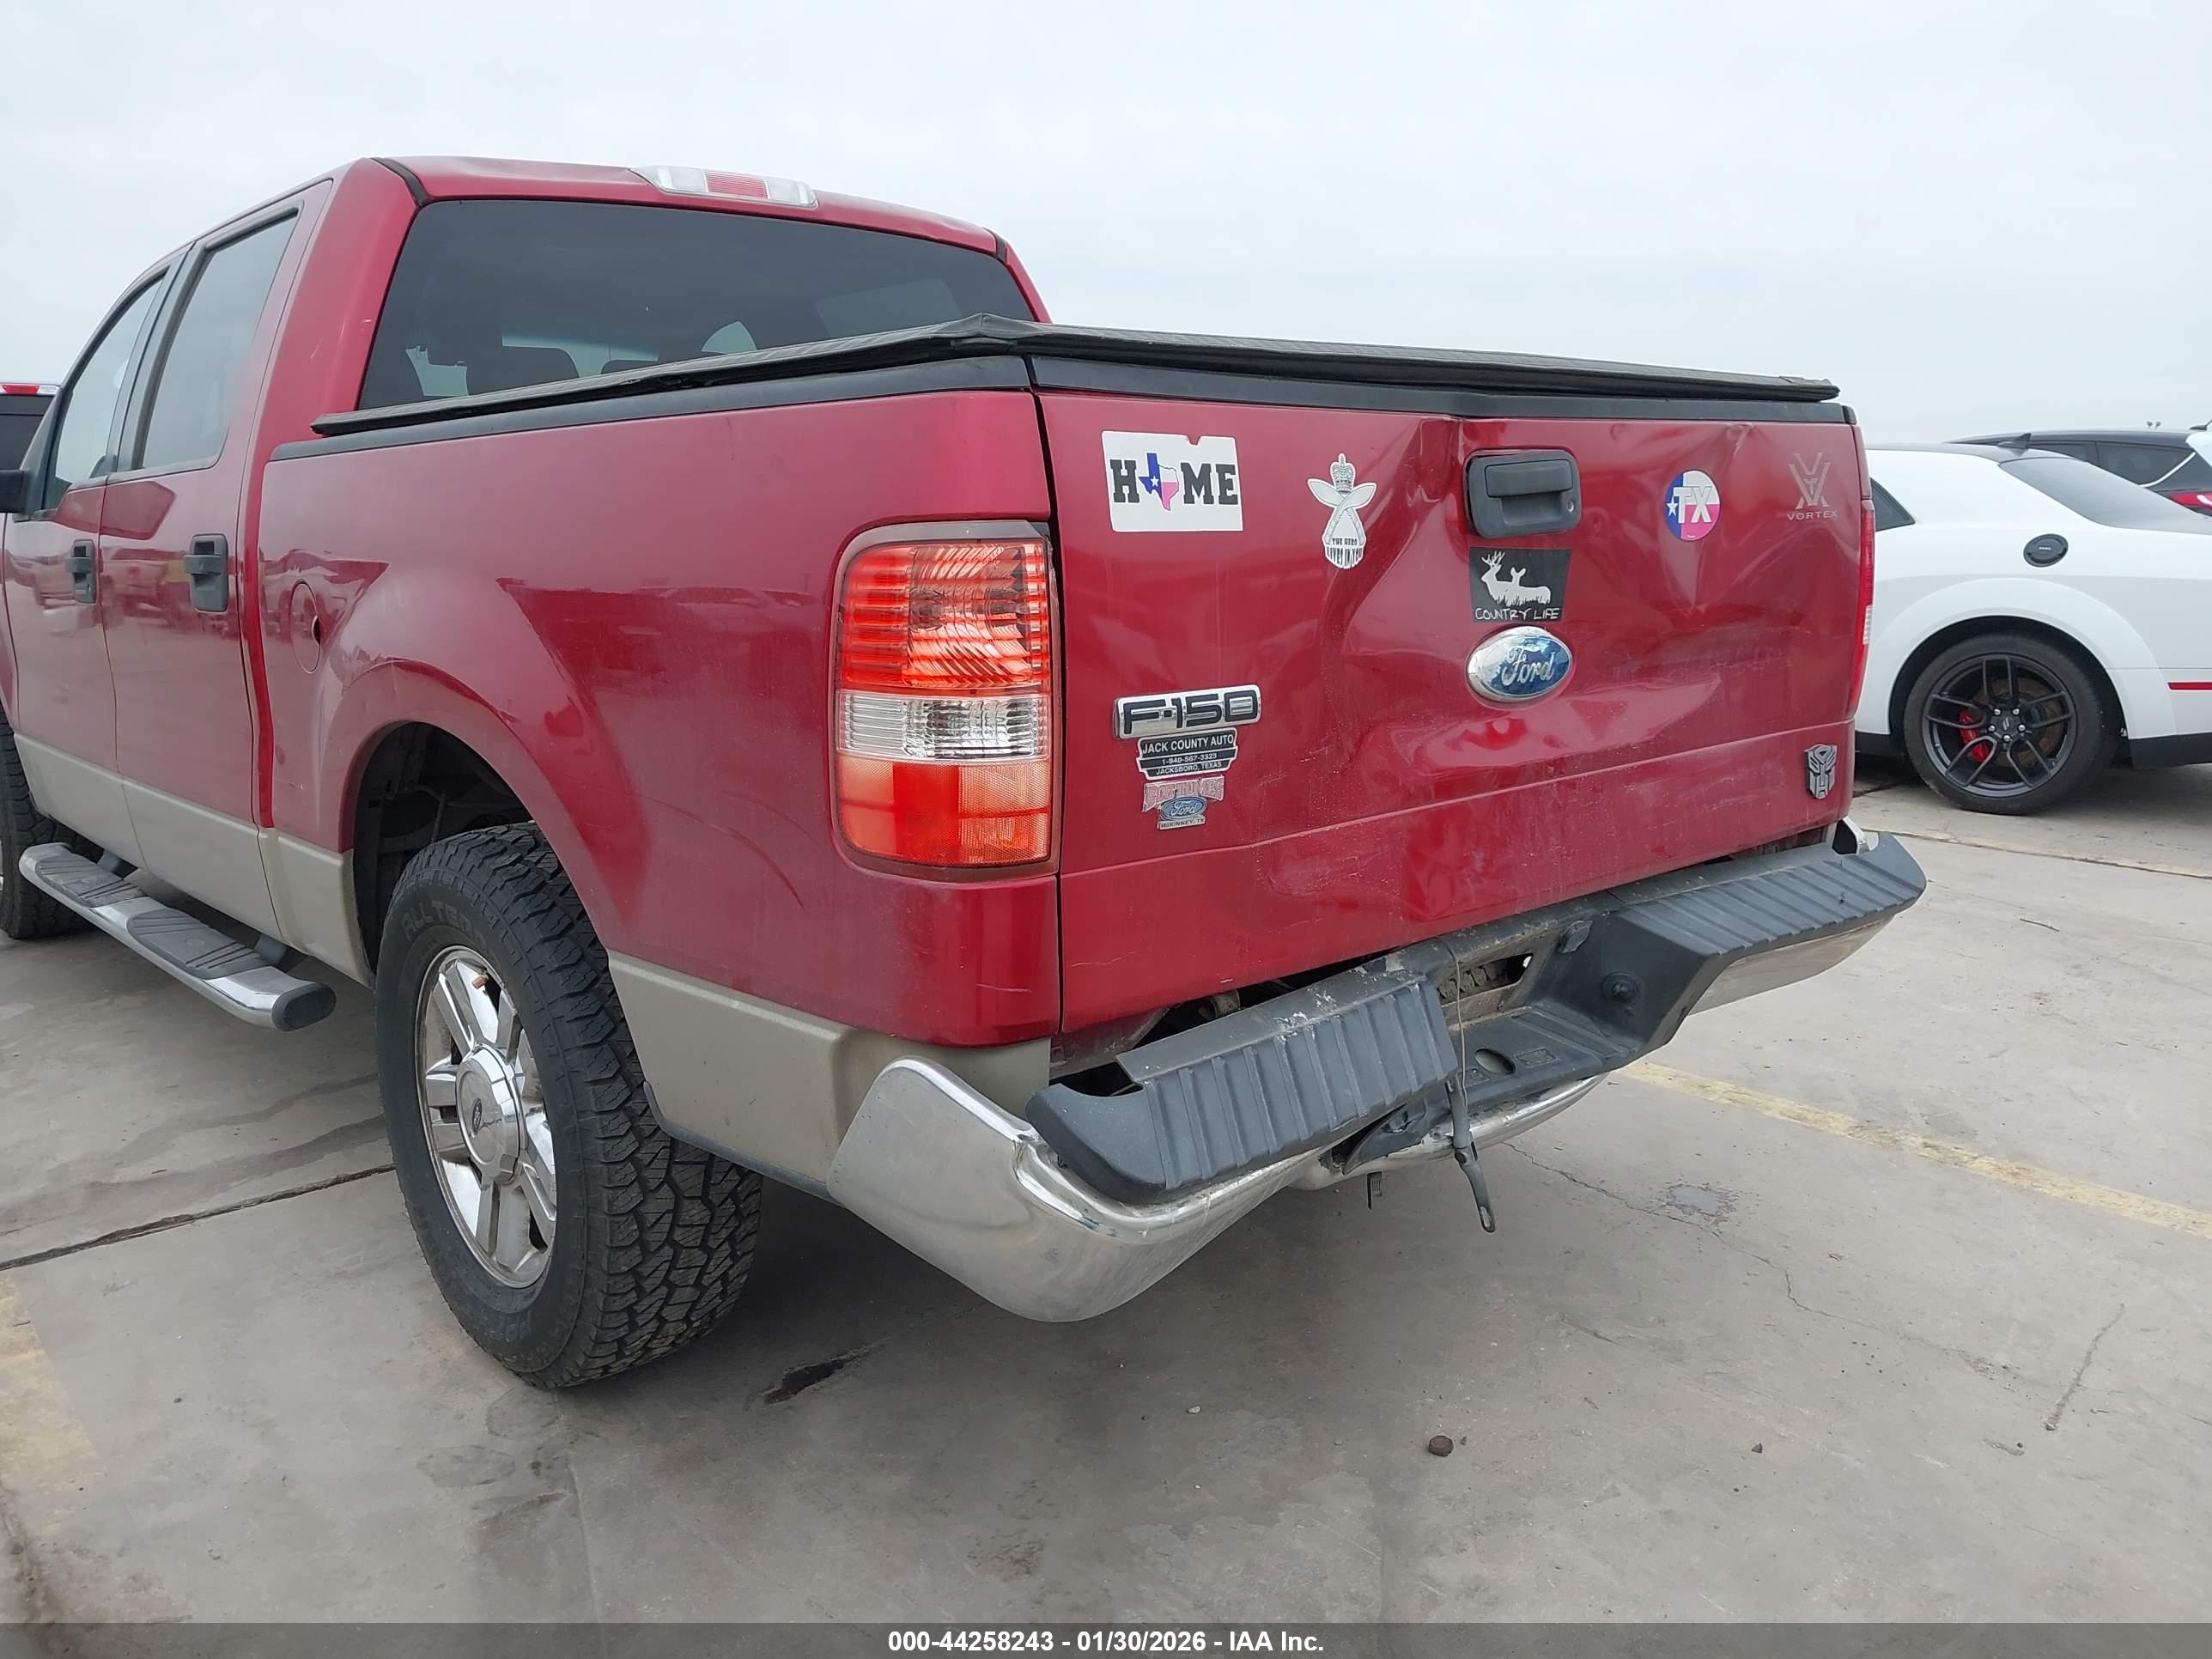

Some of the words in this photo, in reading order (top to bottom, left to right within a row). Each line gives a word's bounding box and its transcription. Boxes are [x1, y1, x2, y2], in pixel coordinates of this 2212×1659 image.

[1109, 453, 1238, 510] HME
[1673, 485, 1712, 523] TX
[1787, 510, 1838, 521] VORTEX
[1475, 608, 1532, 621] COUNTRY
[1534, 608, 1559, 619] LIFE
[1501, 645, 1555, 686] Ford
[1142, 741, 1169, 755] JACK
[1170, 737, 1208, 750] COUNTY
[1210, 733, 1234, 746] AUTO
[1162, 752, 1218, 765] 1-940-567-3323
[1157, 764, 1200, 775] JACKSBORO,
[1201, 761, 1222, 769] TEXAS
[1170, 800, 1199, 816] Ford
